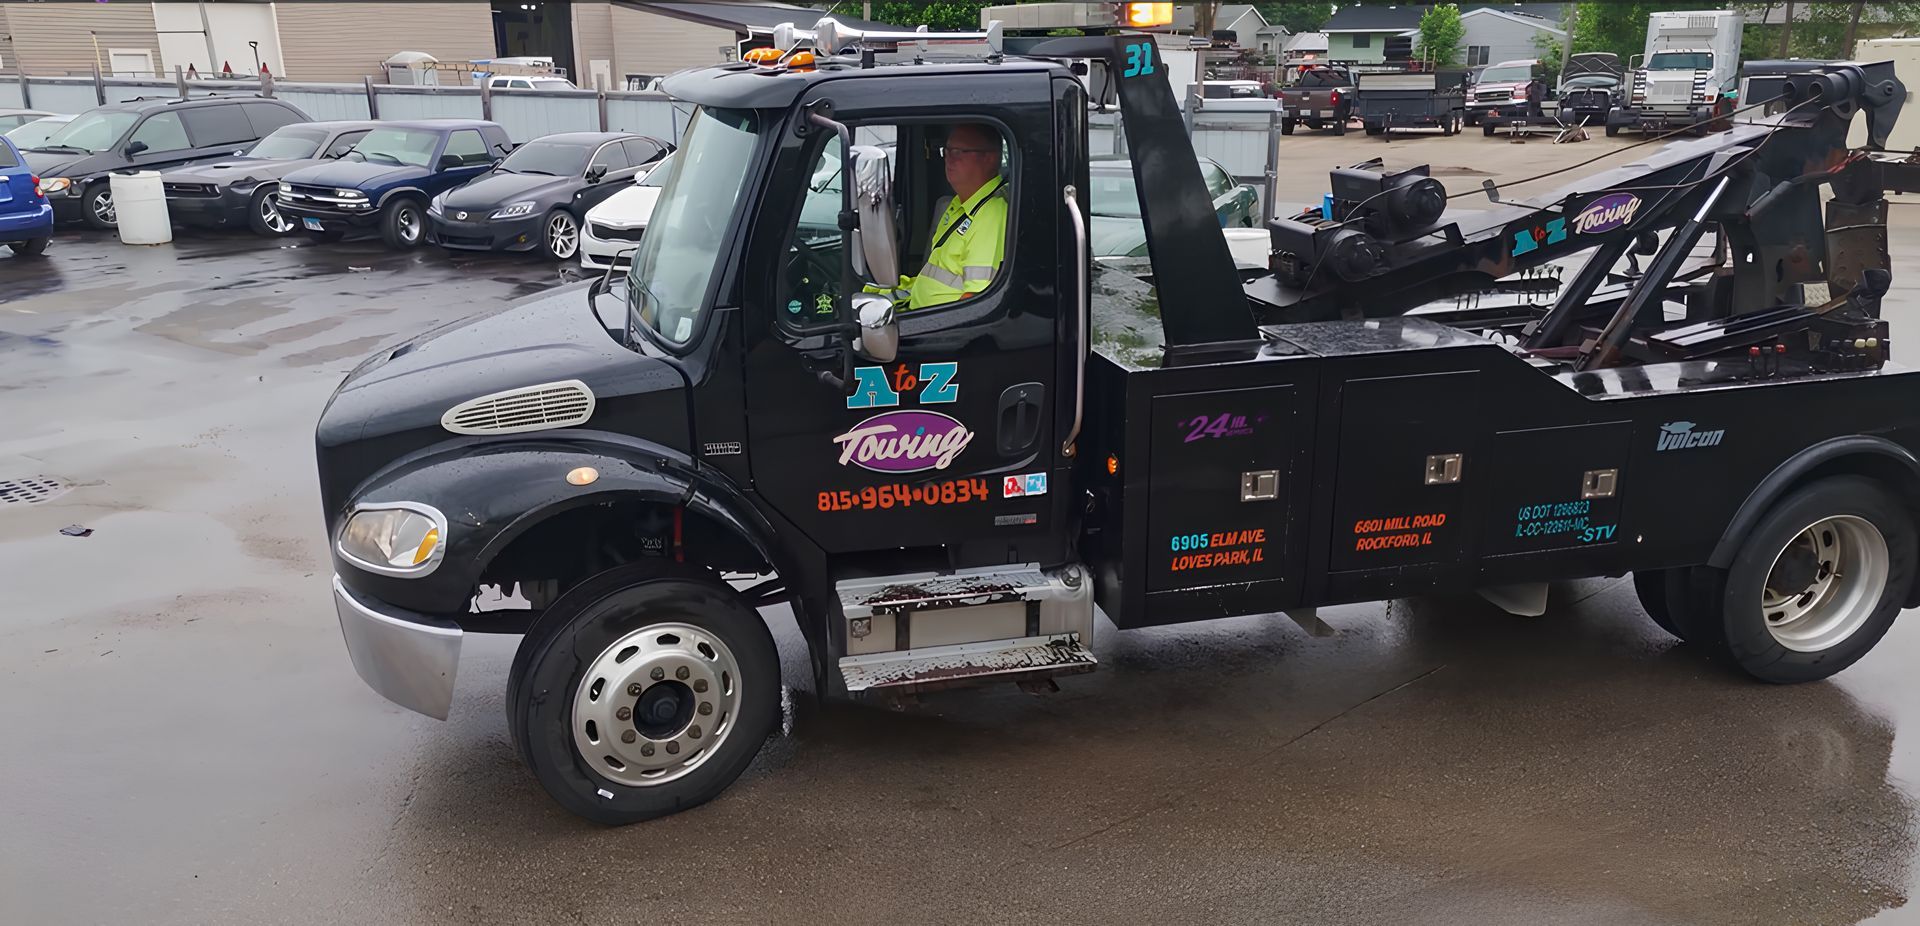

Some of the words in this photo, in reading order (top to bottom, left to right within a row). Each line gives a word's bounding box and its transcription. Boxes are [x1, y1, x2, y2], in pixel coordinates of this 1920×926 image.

[1124, 42, 1154, 78] 31
[1572, 199, 1642, 235] Towing
[1512, 229, 1538, 257] A
[1546, 217, 1567, 245] Z
[847, 366, 899, 409] A
[894, 364, 917, 392] to
[919, 362, 959, 404] Z
[1184, 412, 1232, 443] 24
[1656, 429, 1725, 451] Vulcan
[833, 424, 975, 470] Towing
[1384, 516, 1411, 531] MILL
[1412, 513, 1446, 529] ROAD
[1519, 506, 1532, 521] US
[1532, 504, 1553, 520] DOT
[1171, 533, 1209, 551] 6905
[1210, 531, 1239, 548] ELM
[1356, 533, 1420, 551] ROCKFORD,
[1421, 532, 1432, 545] IL
[1171, 553, 1213, 571] LOVES
[1252, 548, 1264, 562] IL
